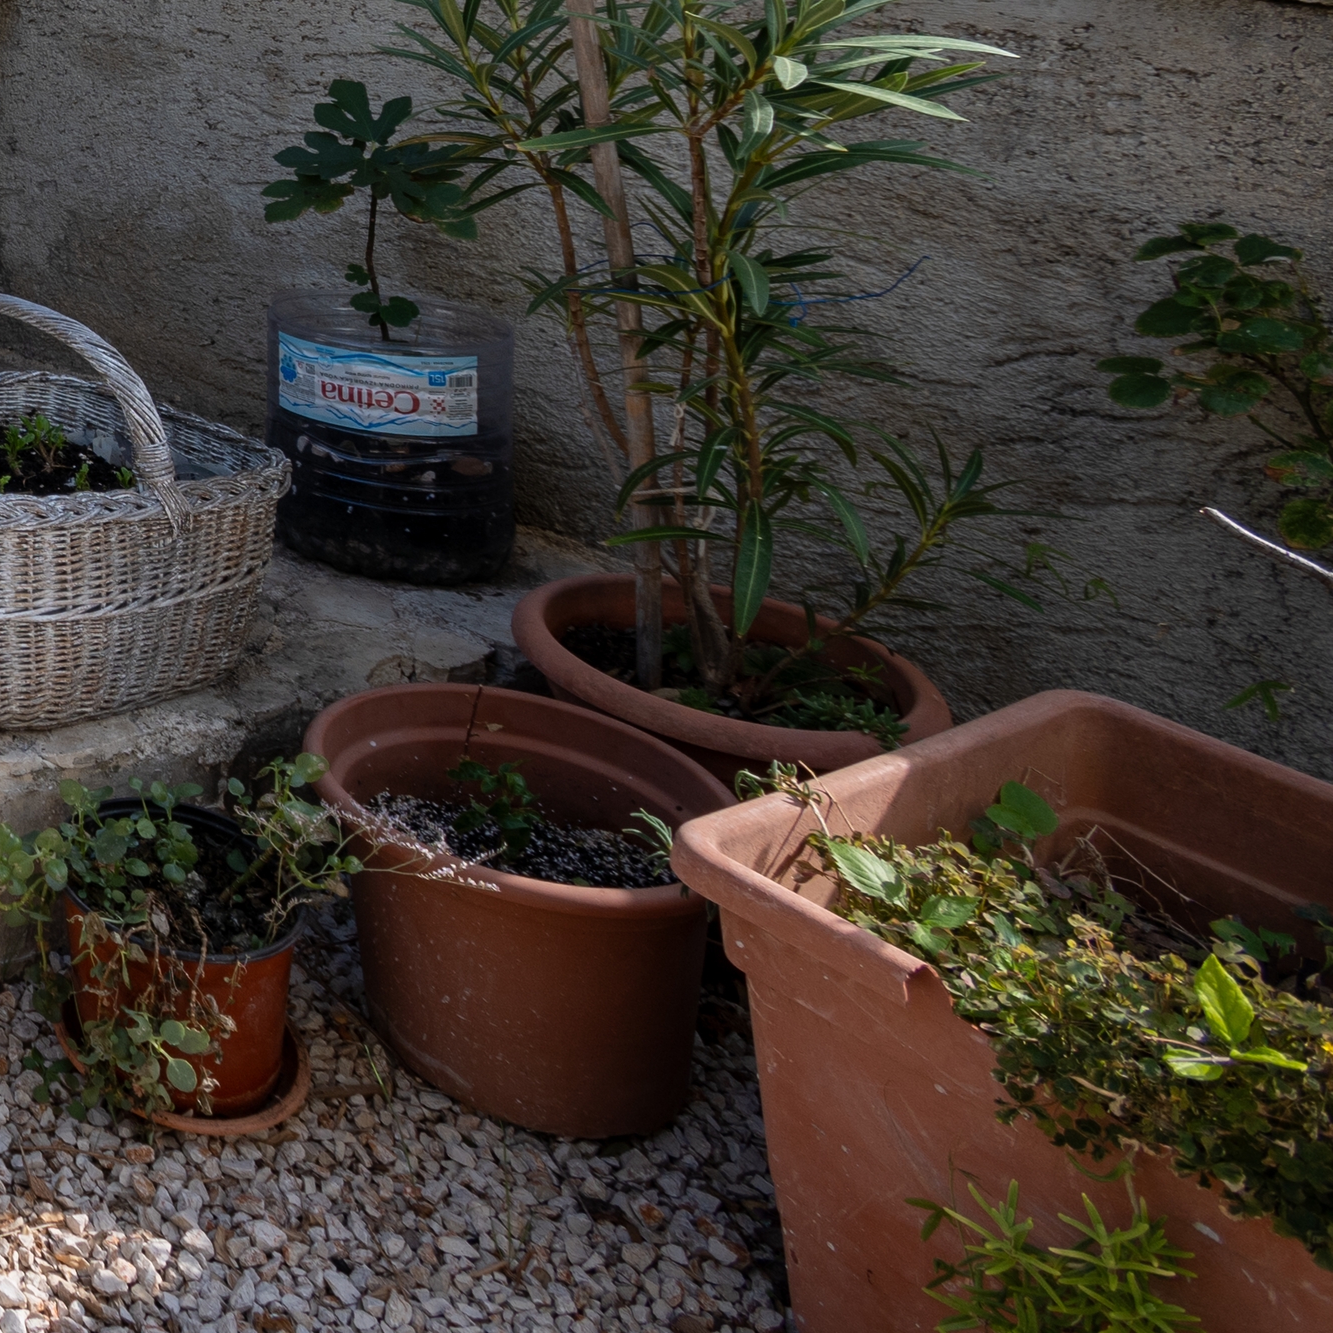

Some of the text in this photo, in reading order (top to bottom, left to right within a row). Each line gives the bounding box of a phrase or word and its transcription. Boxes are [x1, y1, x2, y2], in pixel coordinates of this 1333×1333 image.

[320, 372, 338, 380] VODA
[430, 374, 445, 383] 15L
[379, 382, 419, 390] PRIRODNA
[321, 380, 420, 415] Cetina
